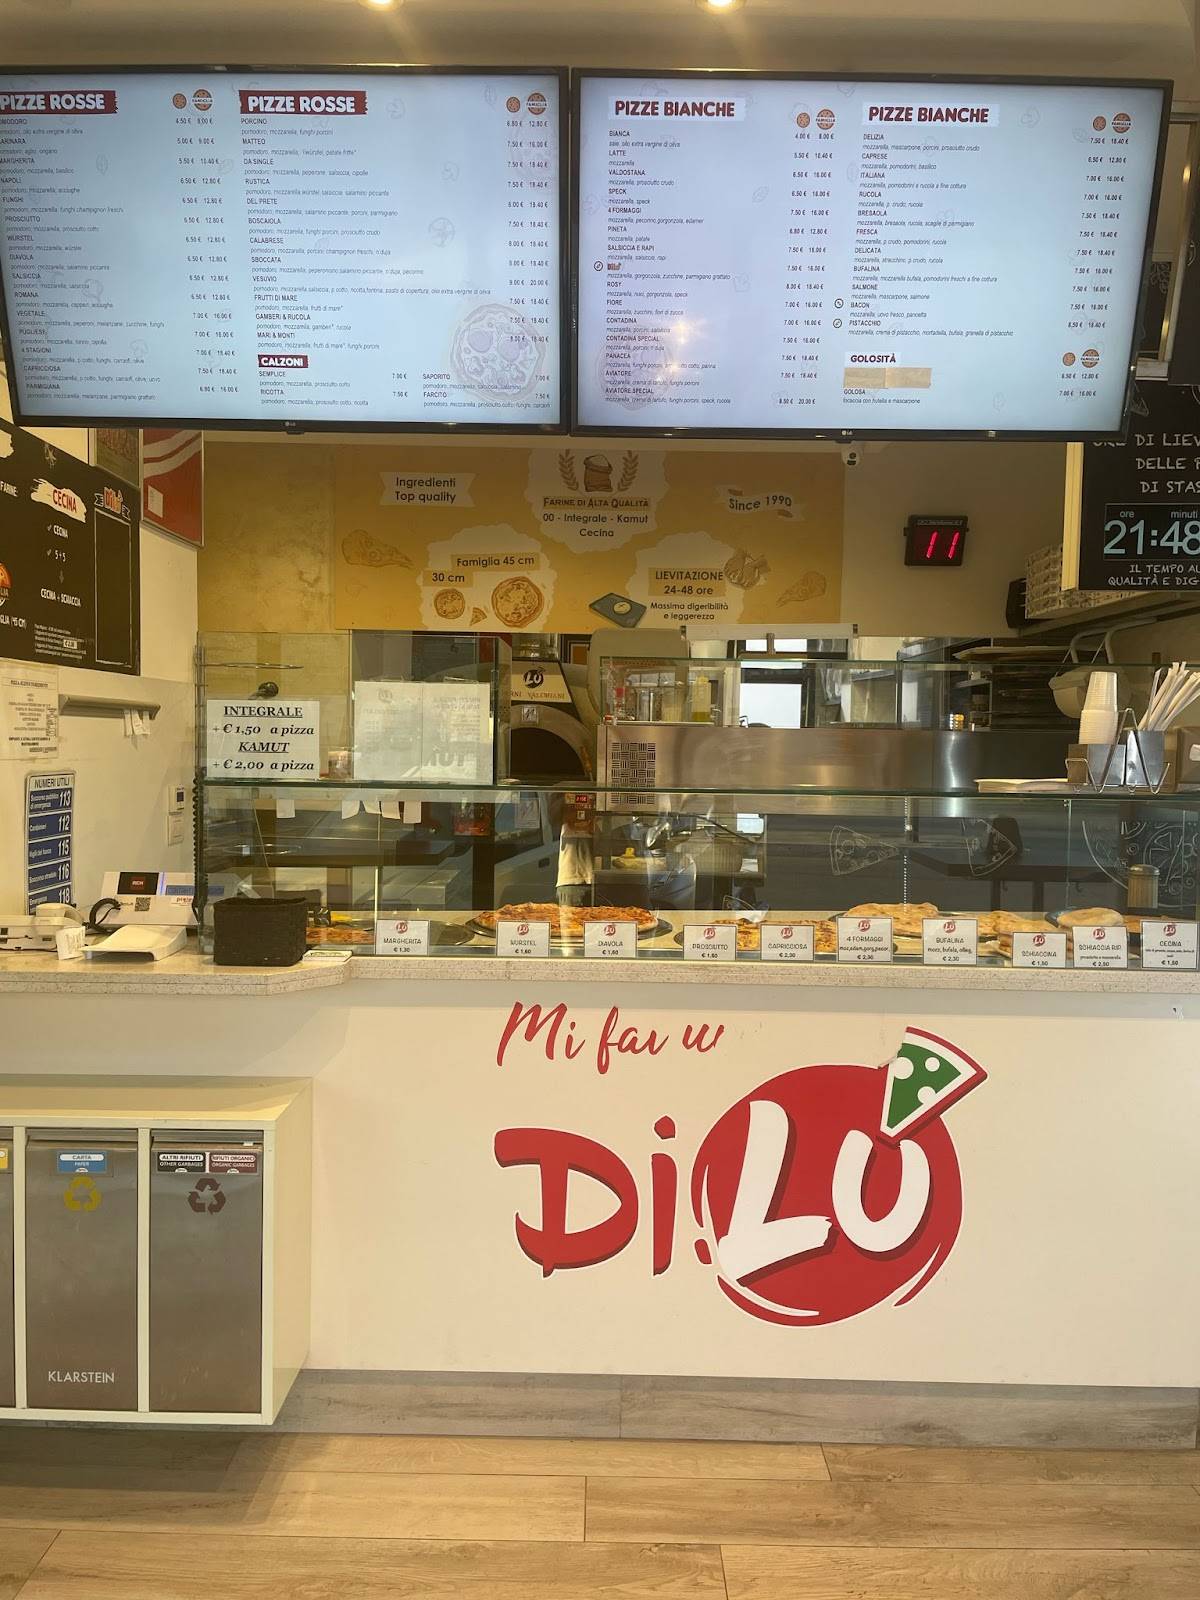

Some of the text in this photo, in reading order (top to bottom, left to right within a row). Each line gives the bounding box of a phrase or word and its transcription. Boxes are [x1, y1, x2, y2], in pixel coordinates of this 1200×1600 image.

[0, 94, 105, 110] PIZZE ROSSE
[248, 96, 355, 113] PIZZE ROSSE
[615, 100, 735, 117] PIZZE BIANCHE
[869, 106, 989, 123] PIZZE BIANCHE
[4, 215, 40, 223] PROSCIUTTO
[261, 357, 303, 366] CALZONI
[850, 355, 896, 363] GOLOSITÀ
[1135, 434, 1154, 446] DI
[1135, 457, 1186, 469] DELLE
[396, 477, 456, 489] Ingredienti
[1140, 481, 1158, 493] DI
[52, 488, 78, 513] CECINA
[395, 491, 456, 503] Top quality
[543, 497, 575, 507] FARINE
[587, 498, 609, 508] ALTA
[729, 495, 792, 511] Since 1990
[542, 513, 555, 522] 00
[564, 514, 607, 525] Integrale
[617, 514, 648, 523] Kamut
[1171, 510, 1198, 519] minuti
[53, 525, 68, 538] CECINA
[579, 528, 614, 537] Cecina
[1103, 520, 1200, 555] 21:48
[926, 532, 959, 558] 11
[55, 550, 59, 559] 5
[457, 557, 500, 568] Famiglia
[503, 556, 515, 565] 45
[1129, 564, 1142, 573] IL
[1146, 564, 1184, 573] TEMPO
[432, 573, 445, 582] 30
[655, 571, 723, 580] LIEVITAZIONE
[1108, 574, 1158, 586] QUALITÀ
[1162, 577, 1170, 585] E
[41, 588, 56, 600] CECINA
[664, 585, 693, 595] 24-48
[687, 603, 729, 611] digeribilità
[224, 706, 302, 717] INTEGRALE
[223, 724, 233, 733] €
[281, 725, 314, 737] pizza
[238, 742, 290, 753] KAMUT
[223, 759, 233, 769] €
[281, 760, 314, 772] pizza
[34, 777, 70, 788] NUMERI UTILI
[60, 790, 71, 807] 113
[58, 815, 70, 832] 112
[58, 839, 70, 857] 115
[58, 863, 70, 881] 116
[58, 887, 70, 904] 118
[496, 1000, 586, 1067] Mi
[48, 1371, 114, 1383] KLARSTEIN
